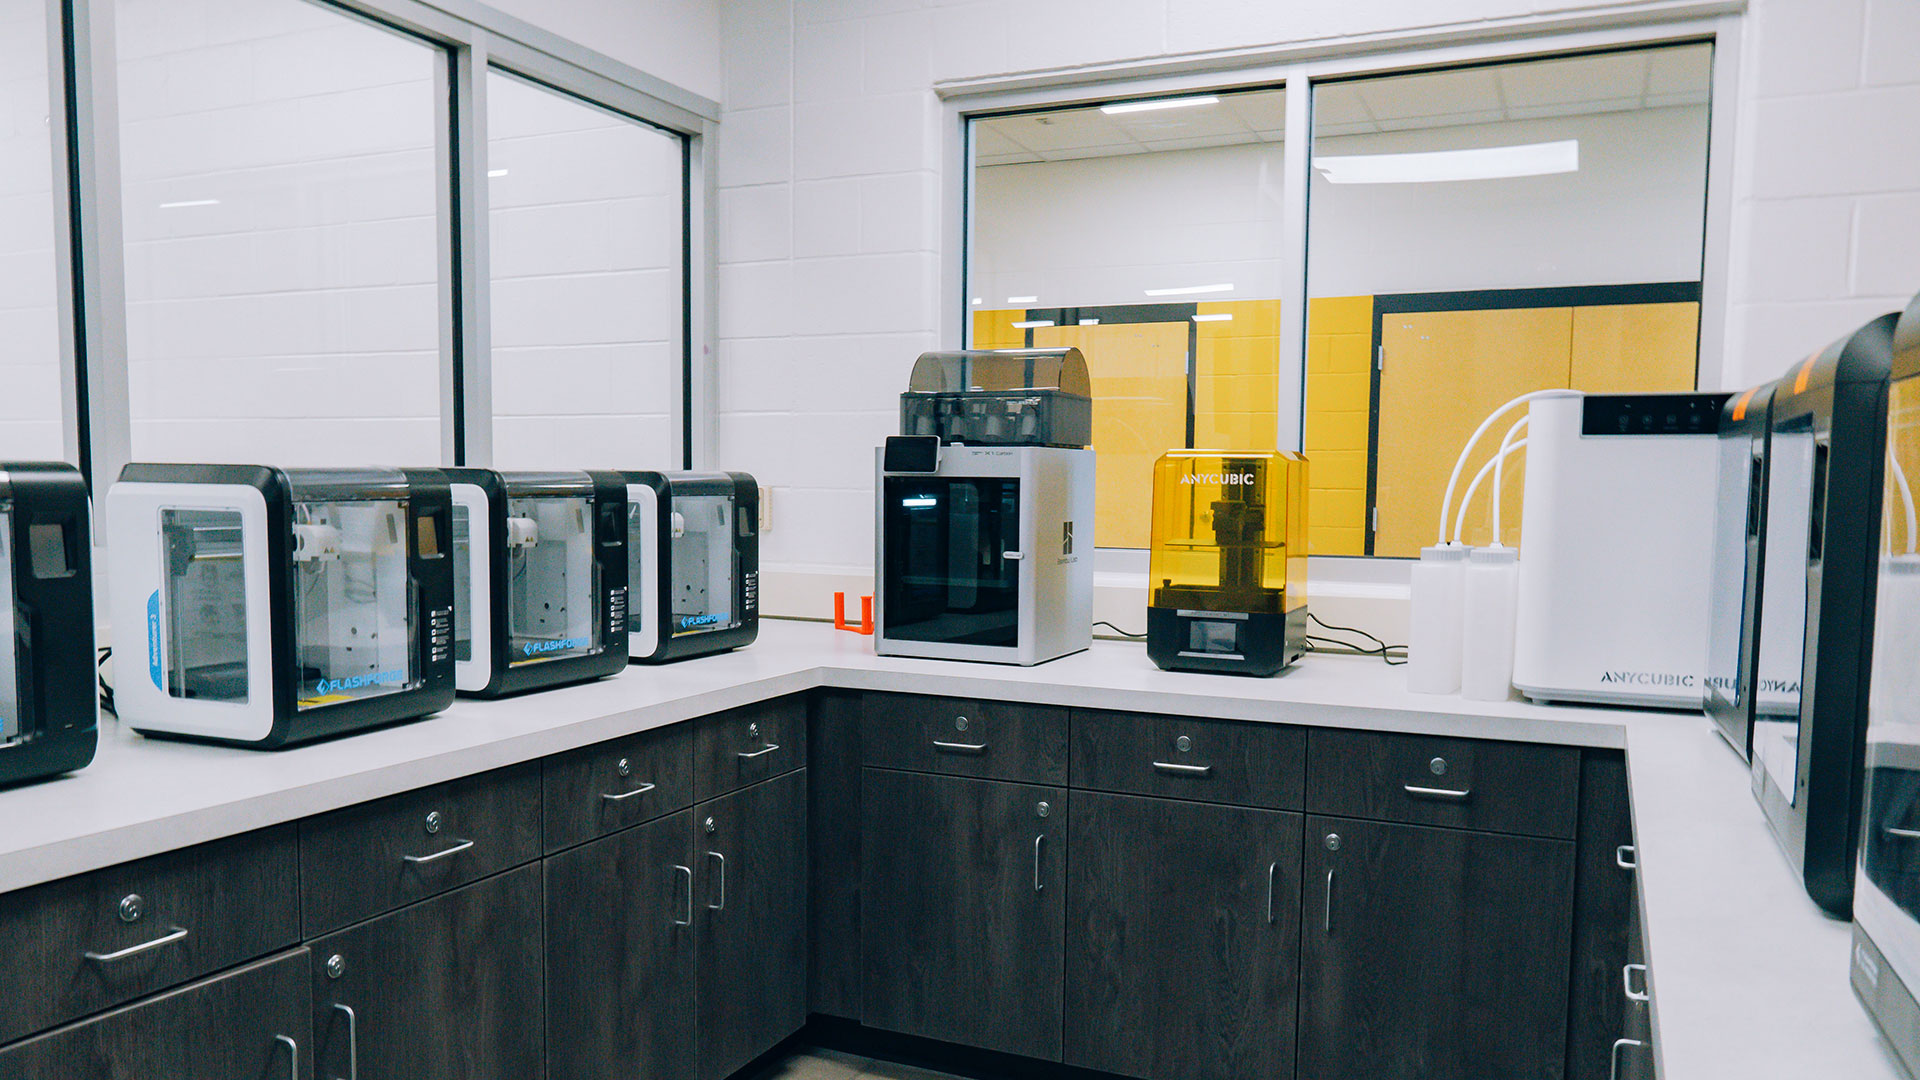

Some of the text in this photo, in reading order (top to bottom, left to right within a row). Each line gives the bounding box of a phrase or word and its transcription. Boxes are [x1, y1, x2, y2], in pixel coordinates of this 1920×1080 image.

[1180, 473, 1255, 485] ANYCUBIC
[330, 669, 404, 692] FLASHFORGE
[1601, 671, 1695, 688] ANYCUBIC
